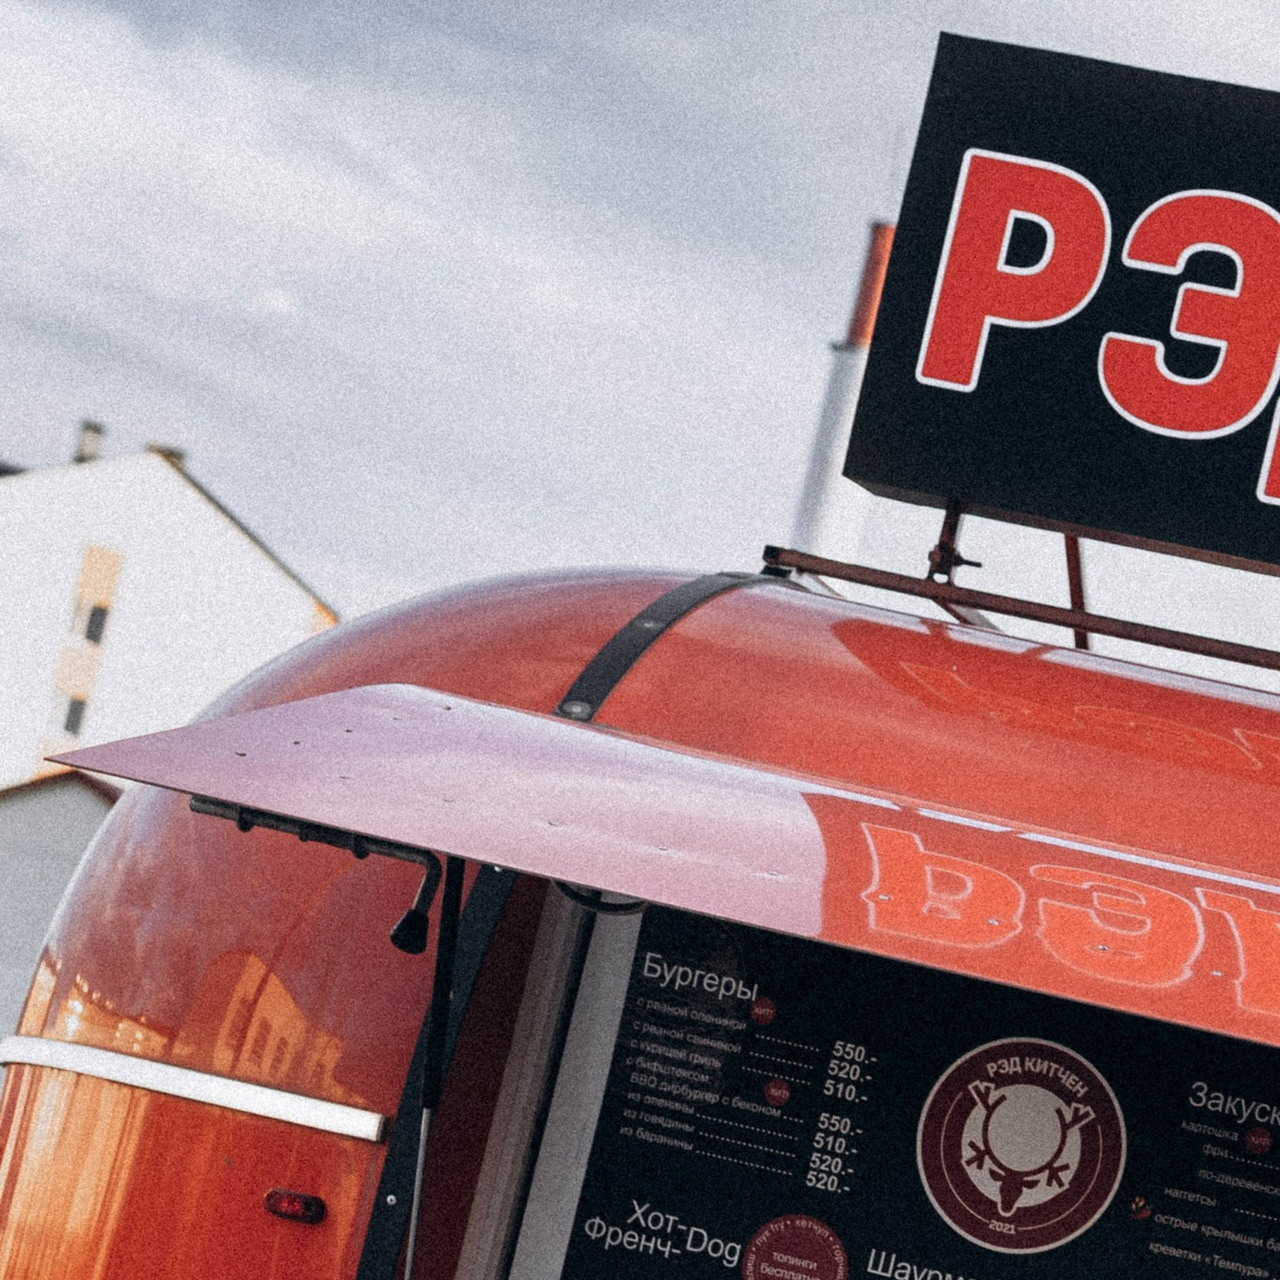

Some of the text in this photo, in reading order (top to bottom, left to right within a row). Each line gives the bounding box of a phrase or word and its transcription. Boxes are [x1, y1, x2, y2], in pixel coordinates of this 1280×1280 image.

[642, 951, 758, 1001] Бургеры
[832, 1040, 877, 1064] 550.-
[827, 1059, 872, 1082] 520.-
[986, 1056, 1089, 1098] РЭД КИТЧЕН
[823, 1078, 868, 1102] 510.-
[818, 1112, 862, 1135] 550.-
[812, 1132, 857, 1155] 510.-
[809, 1152, 854, 1175] 520.-
[805, 1170, 850, 1193] 520.-
[584, 1216, 681, 1258] Френч-
[626, 1199, 742, 1268] Хот- Dog
[988, 1219, 1015, 1234] 2021
[772, 1252, 817, 1270] топинги
